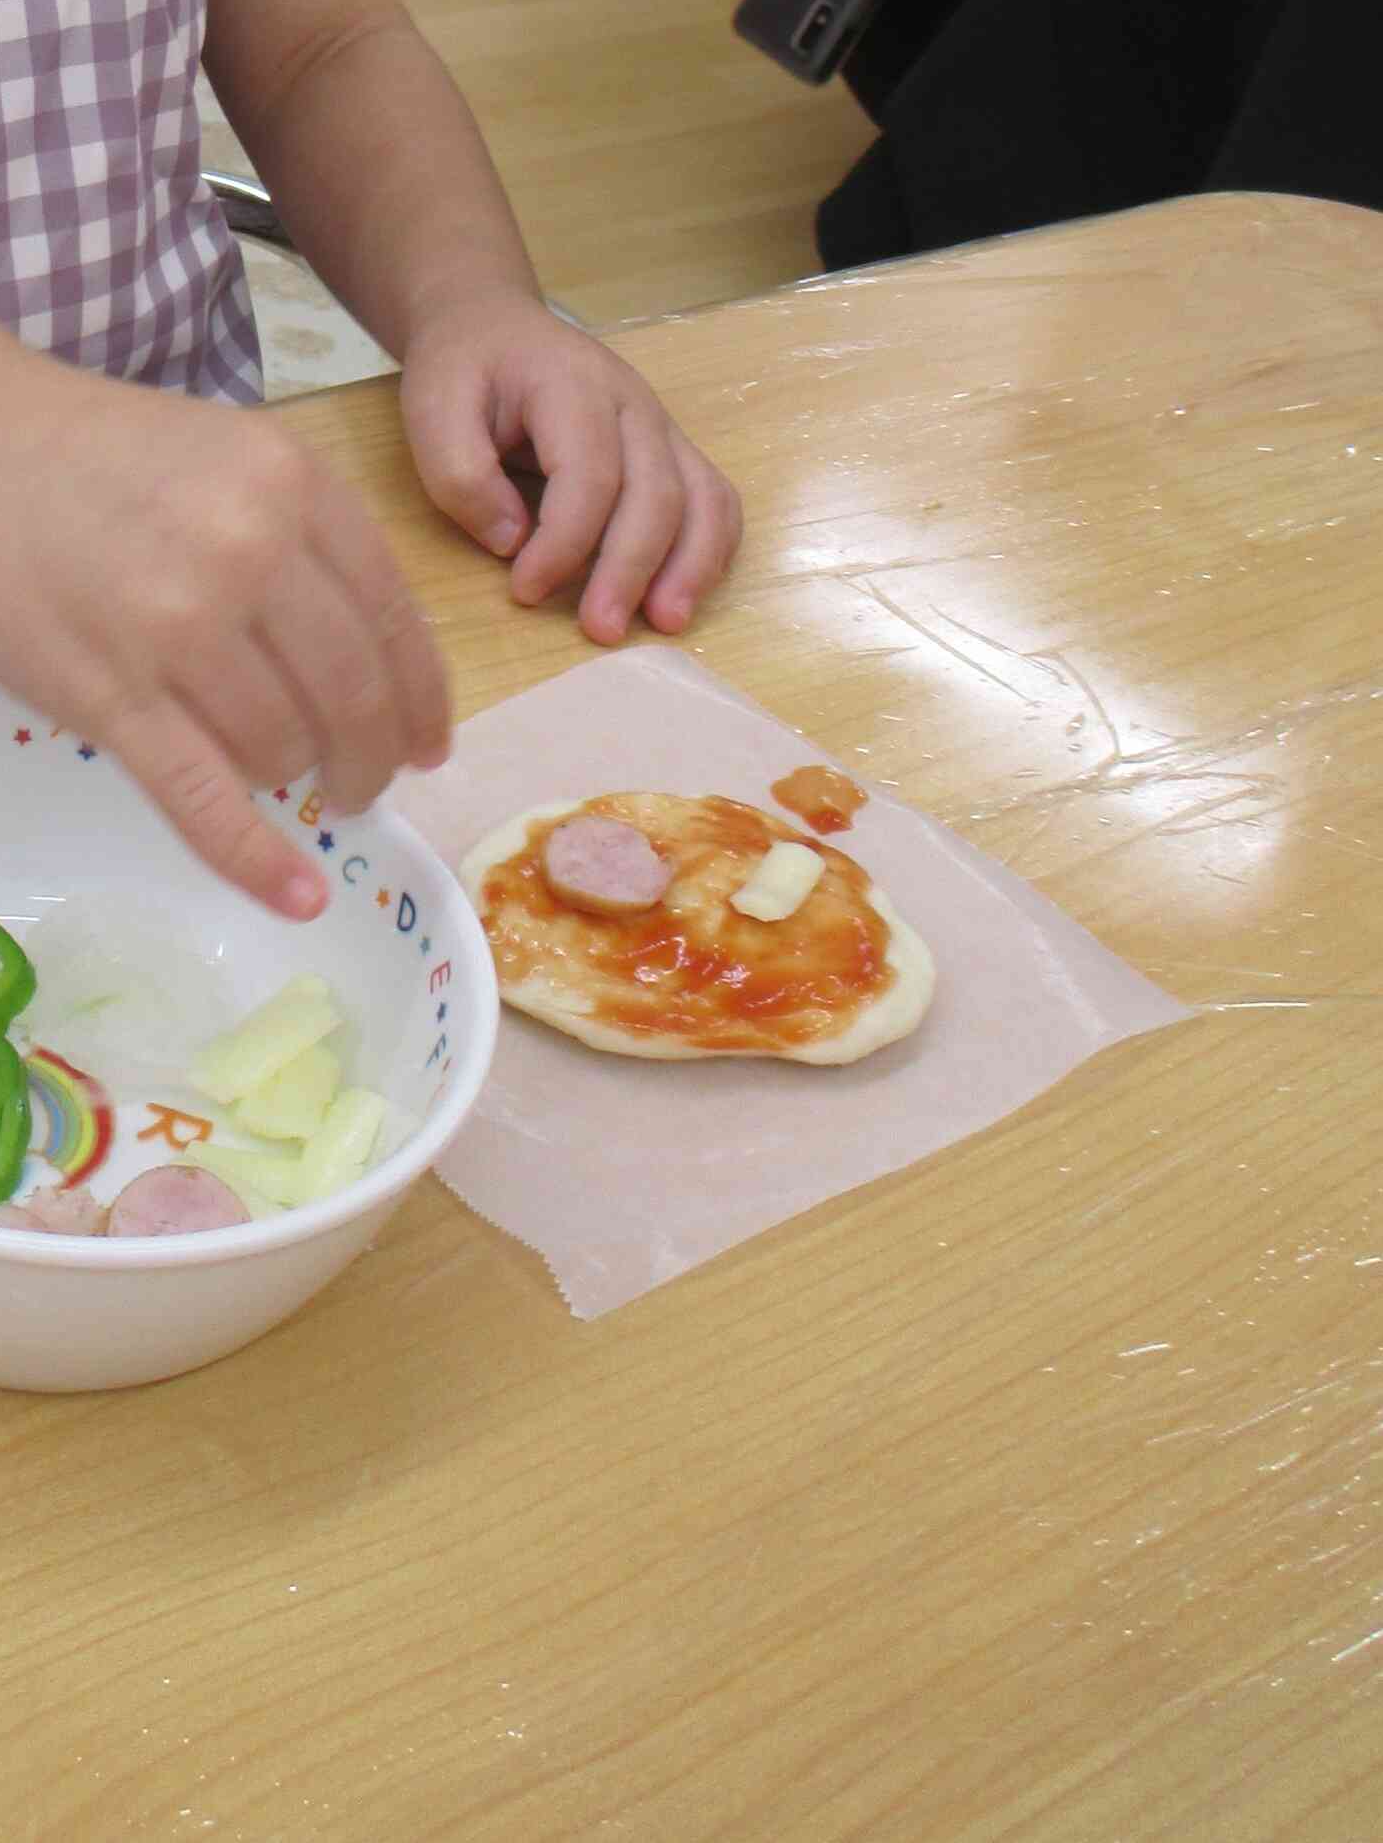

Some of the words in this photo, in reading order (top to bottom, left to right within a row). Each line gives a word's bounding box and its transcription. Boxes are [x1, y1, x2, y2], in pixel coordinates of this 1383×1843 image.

[342, 855, 368, 884] C
[396, 890, 416, 932] D
[430, 960, 451, 995] E
